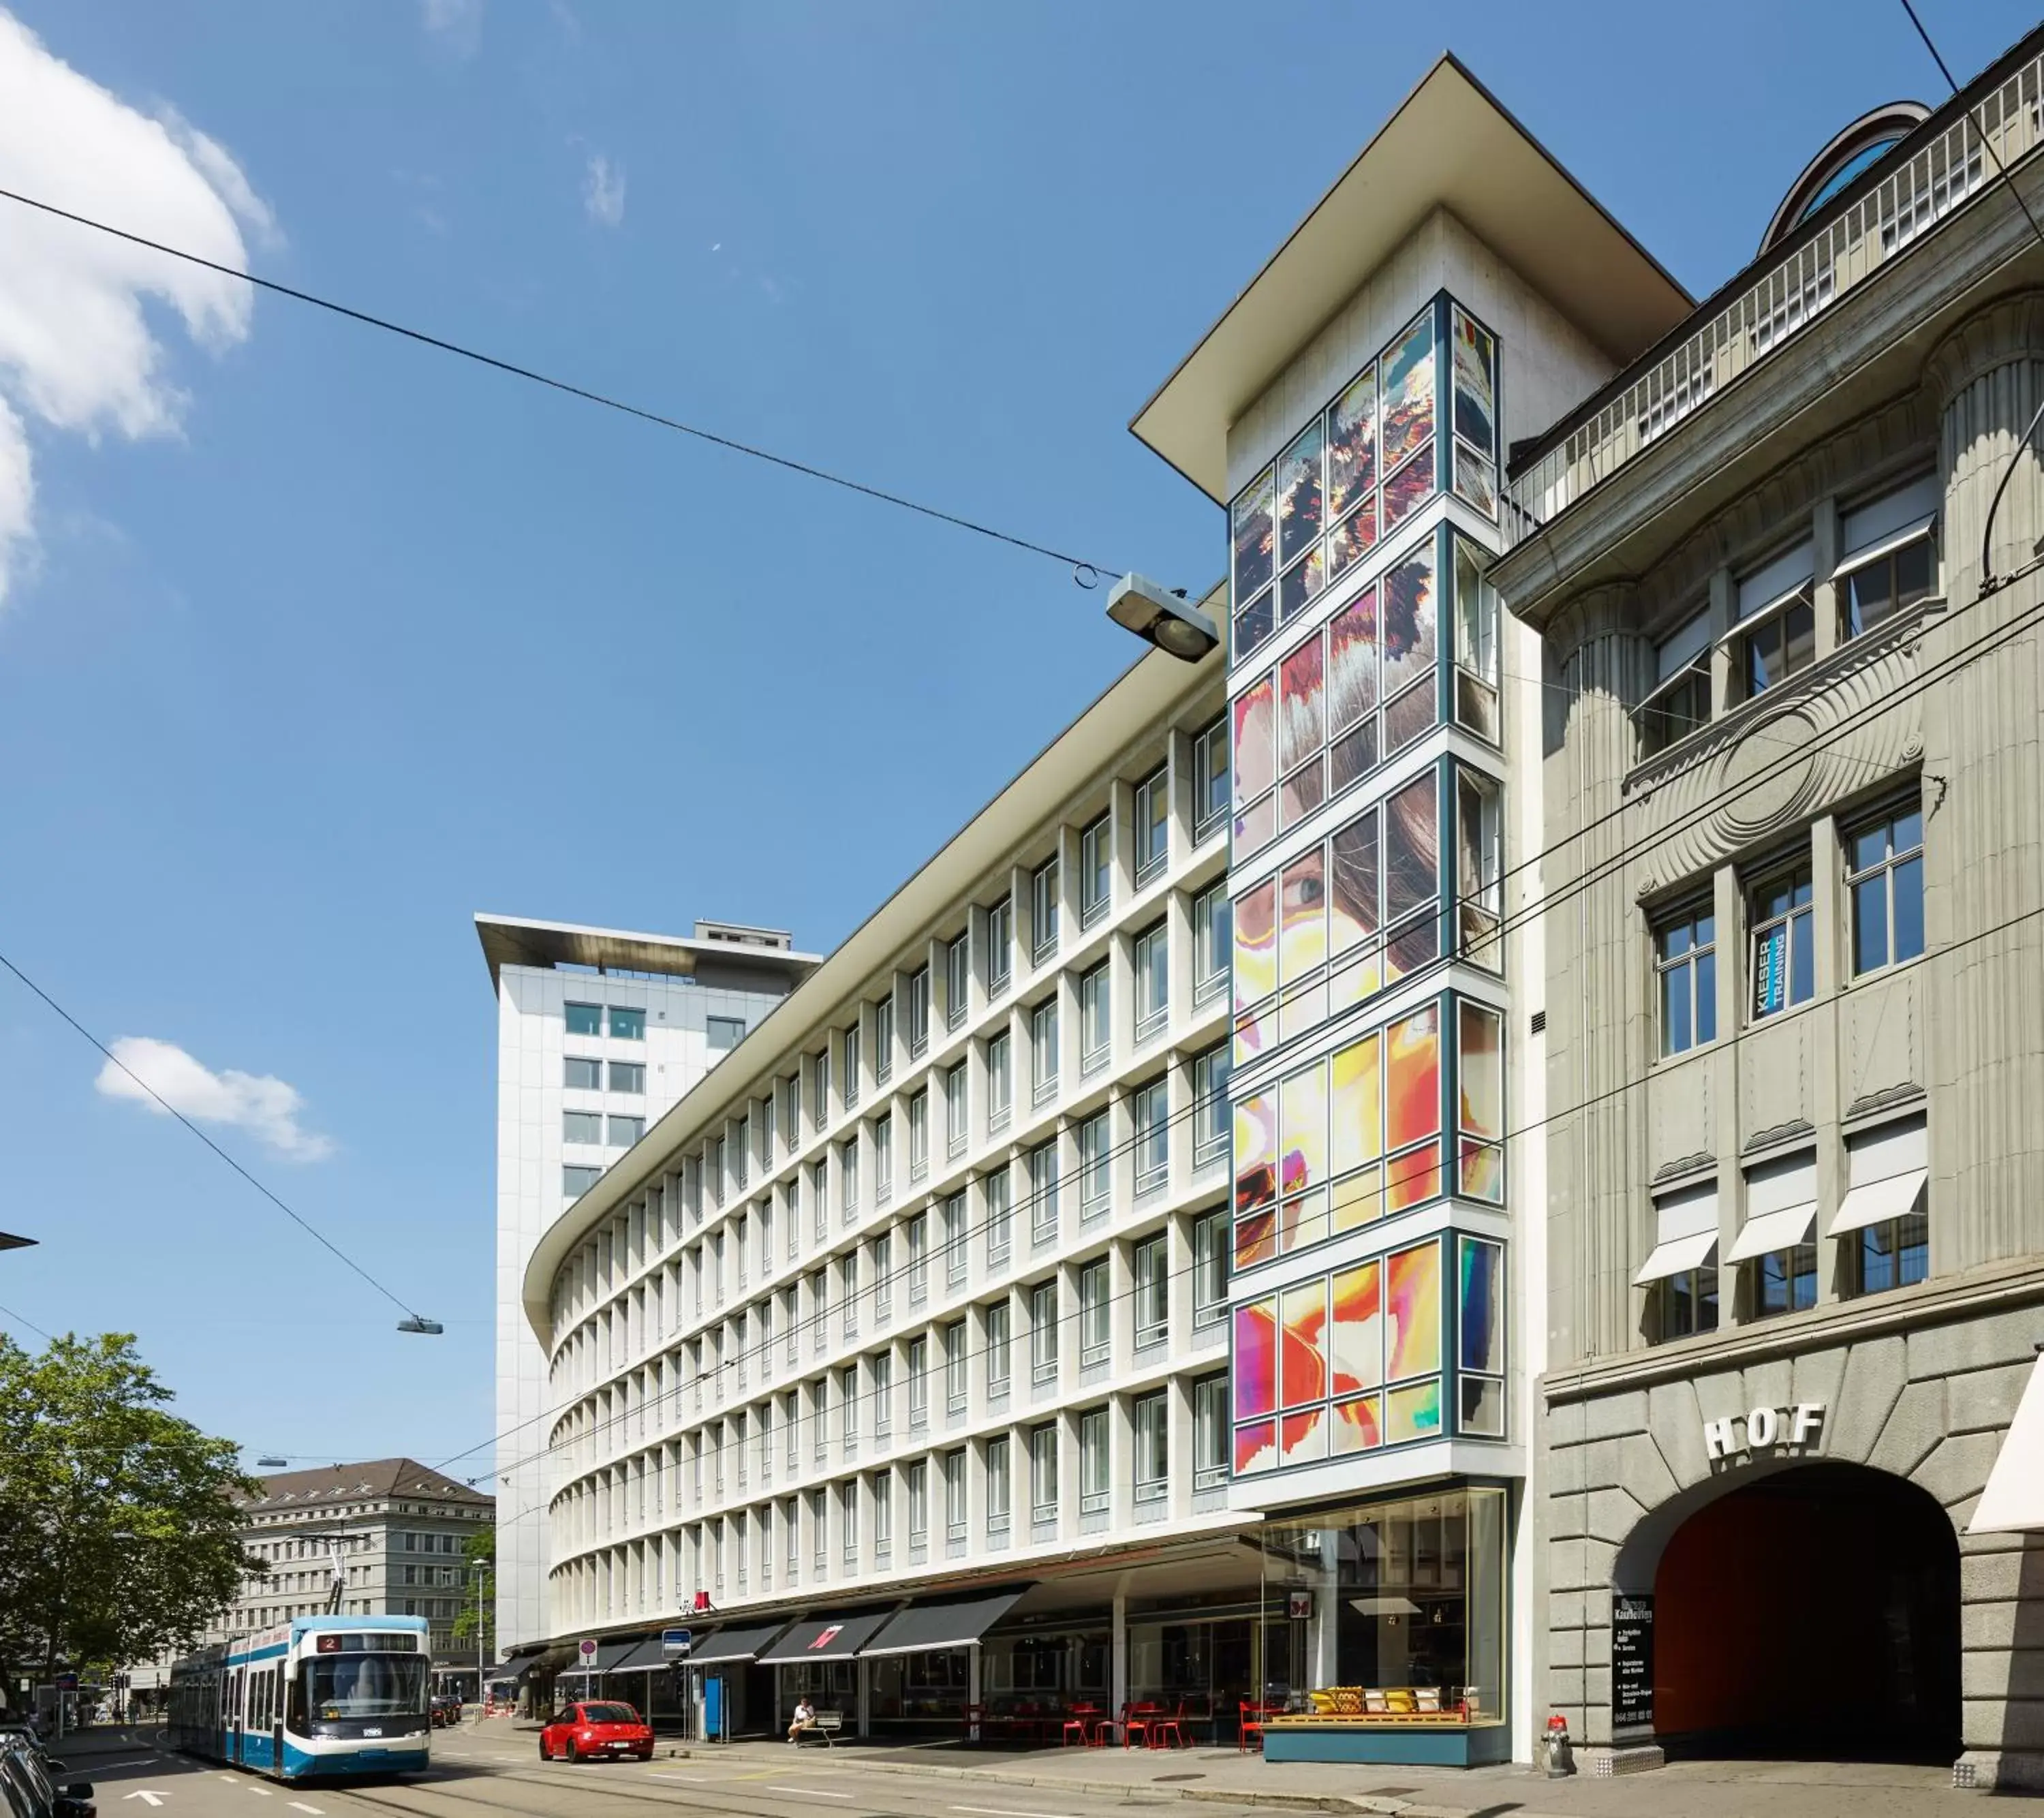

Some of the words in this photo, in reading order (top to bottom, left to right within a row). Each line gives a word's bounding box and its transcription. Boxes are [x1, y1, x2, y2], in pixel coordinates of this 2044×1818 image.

[1757, 939, 1771, 1013] KIESER
[1774, 934, 1785, 1006] TRAINING
[1705, 1403, 1826, 1460] HOF
[326, 1638, 335, 1649] 2
